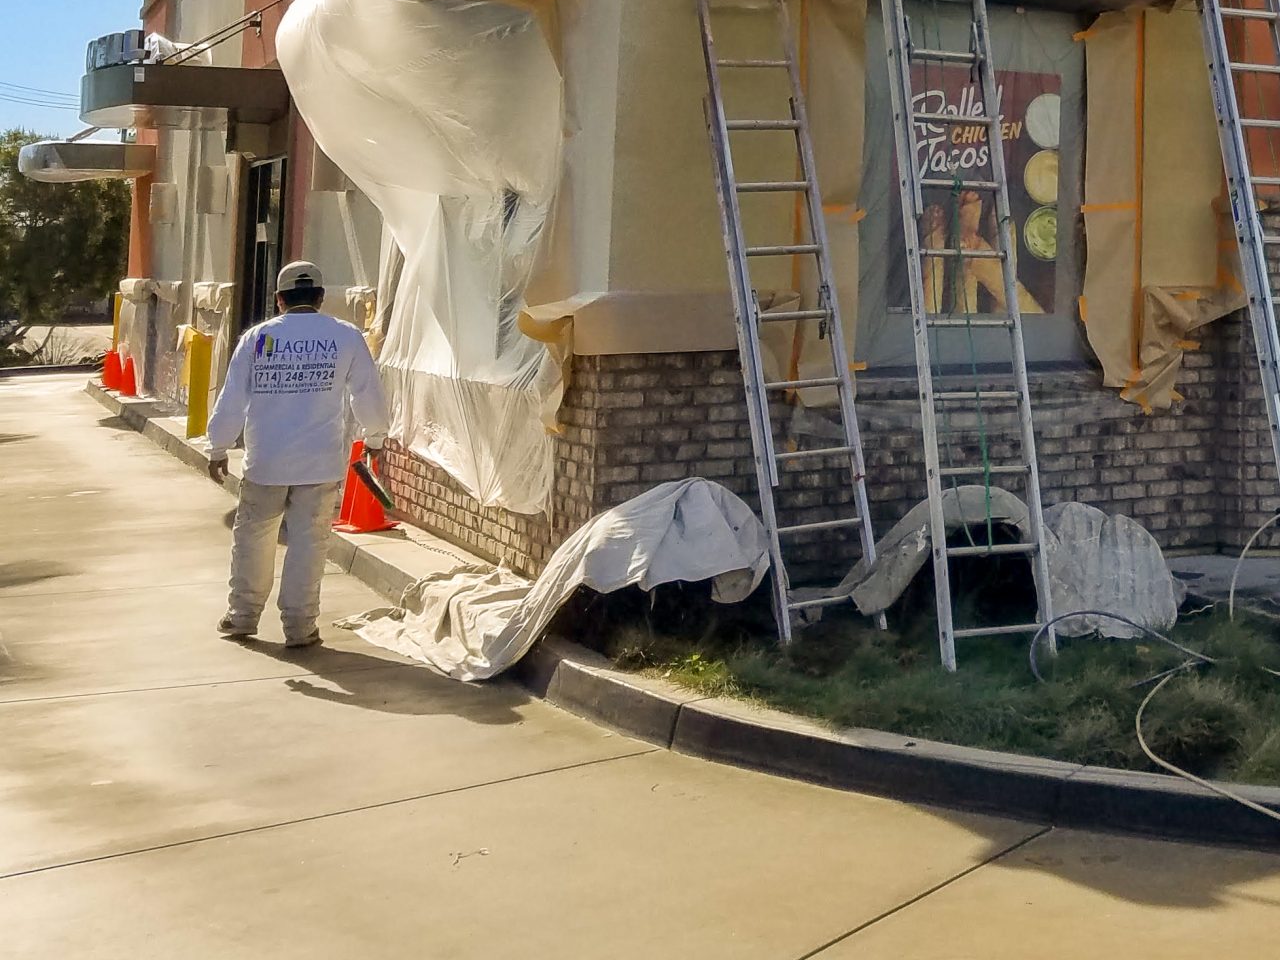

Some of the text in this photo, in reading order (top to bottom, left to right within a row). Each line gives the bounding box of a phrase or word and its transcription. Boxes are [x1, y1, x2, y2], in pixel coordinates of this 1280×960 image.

[951, 120, 1022, 144] CHICEN
[917, 135, 989, 179] Tacos
[274, 338, 338, 354] LAGUNA
[273, 352, 338, 361] PAINTING
[254, 363, 295, 371] COMMERCIAL
[301, 362, 336, 370] RESIDENTIAL
[254, 371, 335, 384] (714) 248-7924
